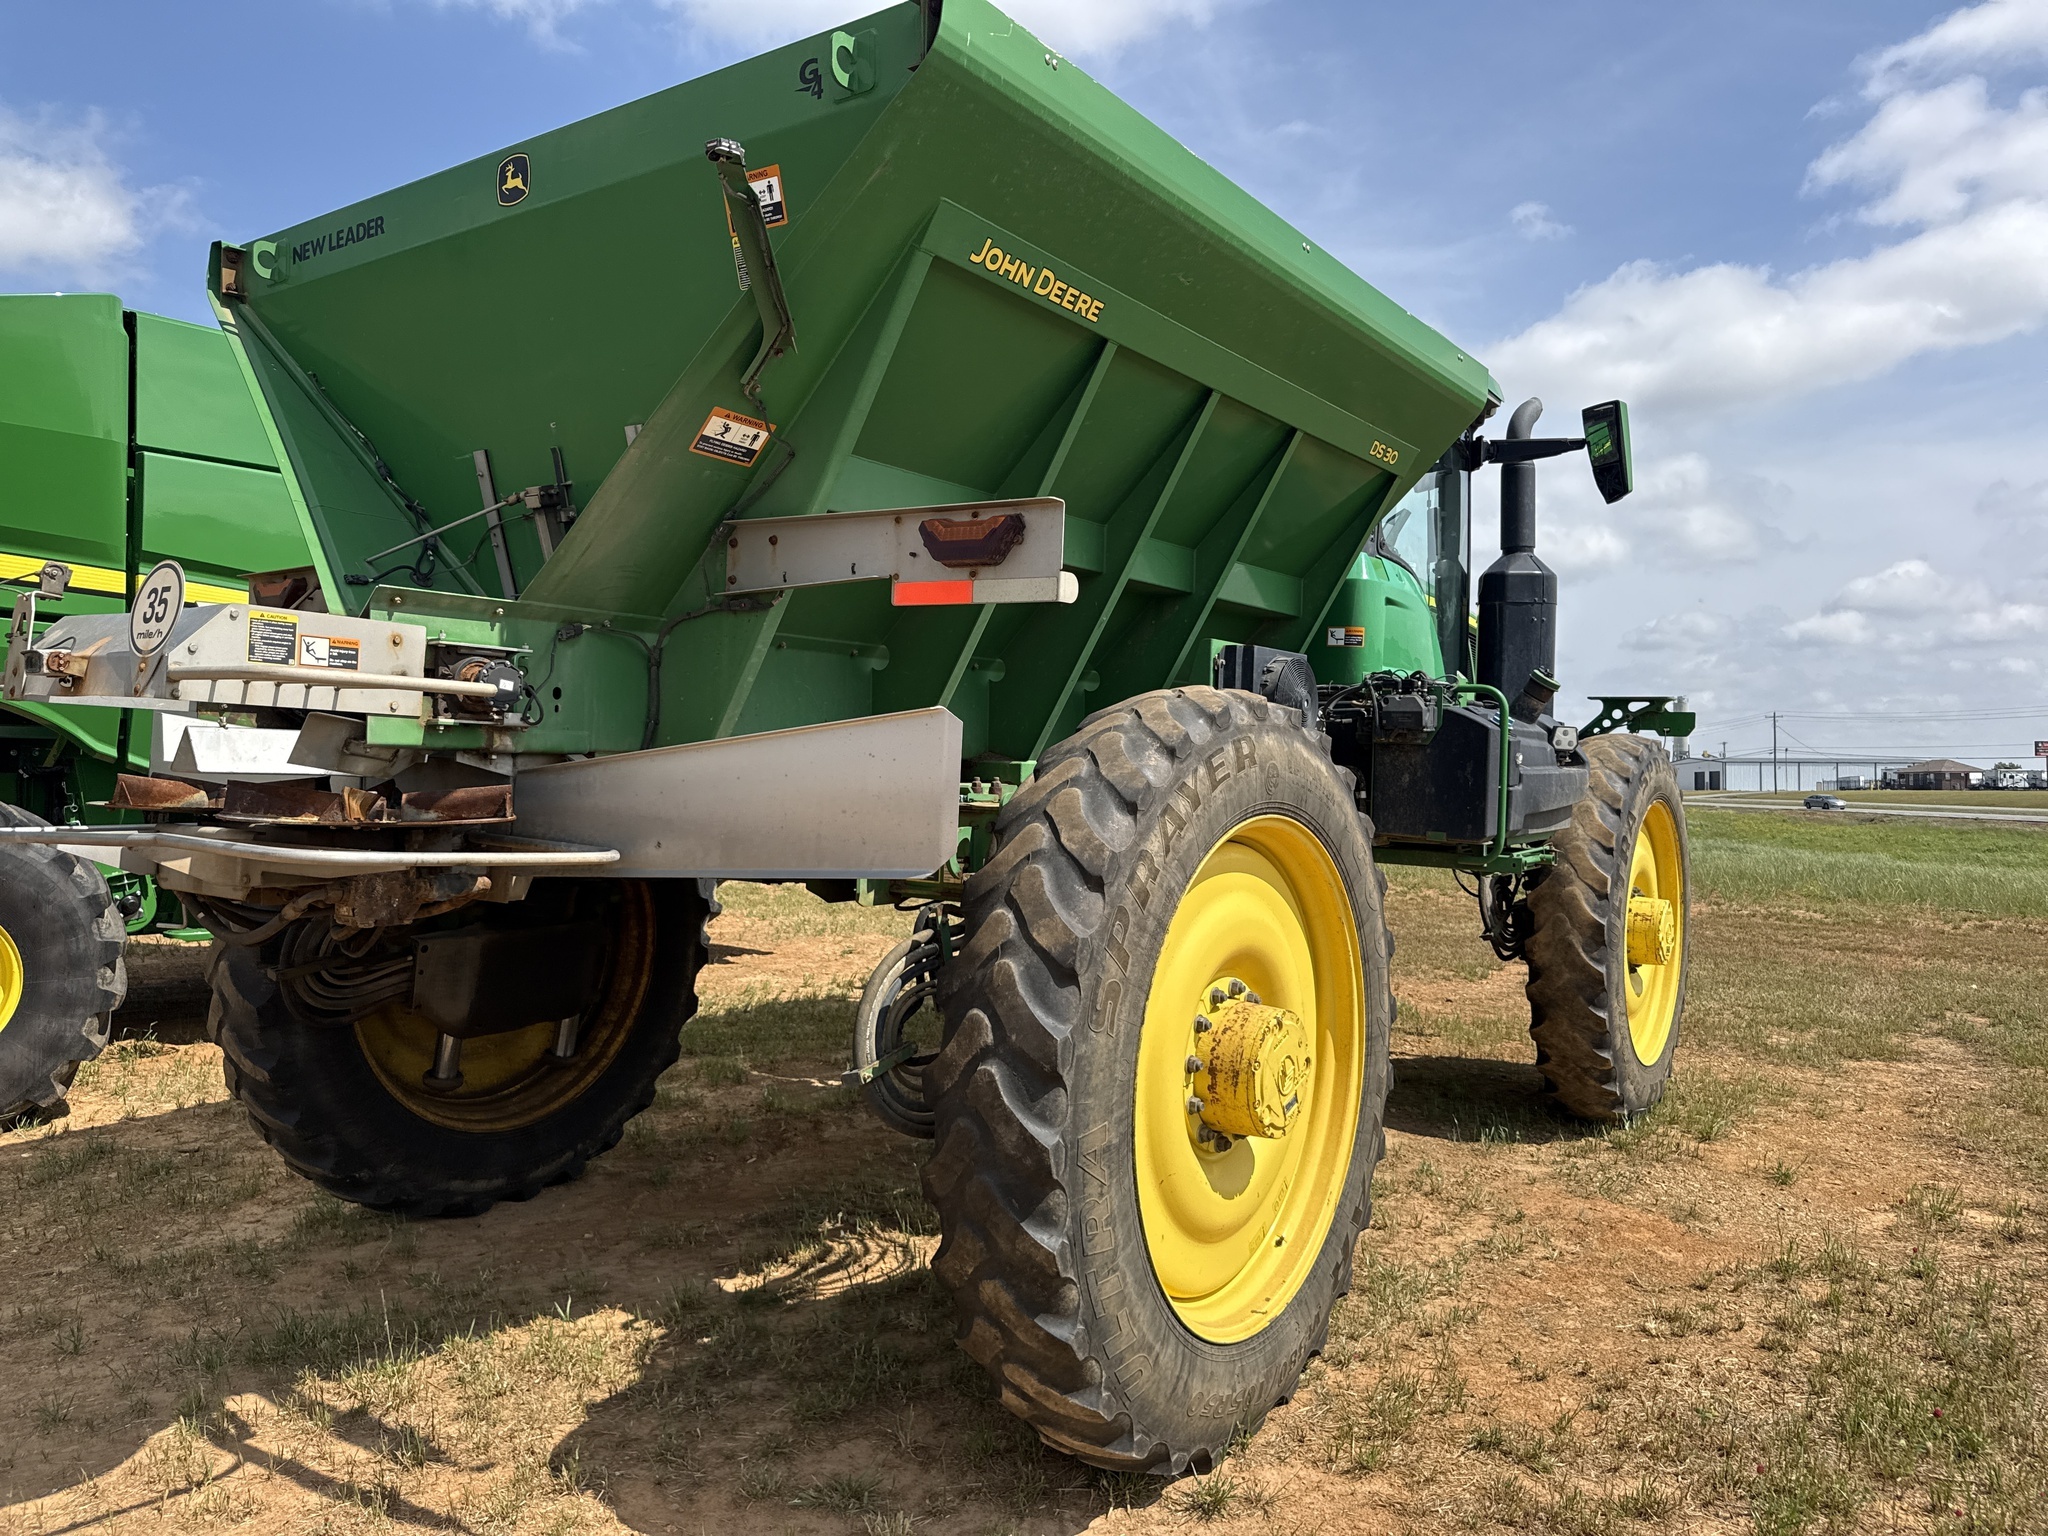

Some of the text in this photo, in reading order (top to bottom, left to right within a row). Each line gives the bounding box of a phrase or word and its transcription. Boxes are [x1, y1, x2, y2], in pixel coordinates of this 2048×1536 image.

[292, 215, 385, 265] NEW LEADER
[969, 237, 1106, 323] JOHN DEERE
[732, 414, 764, 429] WARNING
[142, 585, 172, 624] 35
[266, 613, 288, 621] CAUTION
[136, 628, 163, 640] mile/h
[1088, 735, 1257, 1038] SPRAYER
[1077, 1121, 1153, 1410] ULTRA
